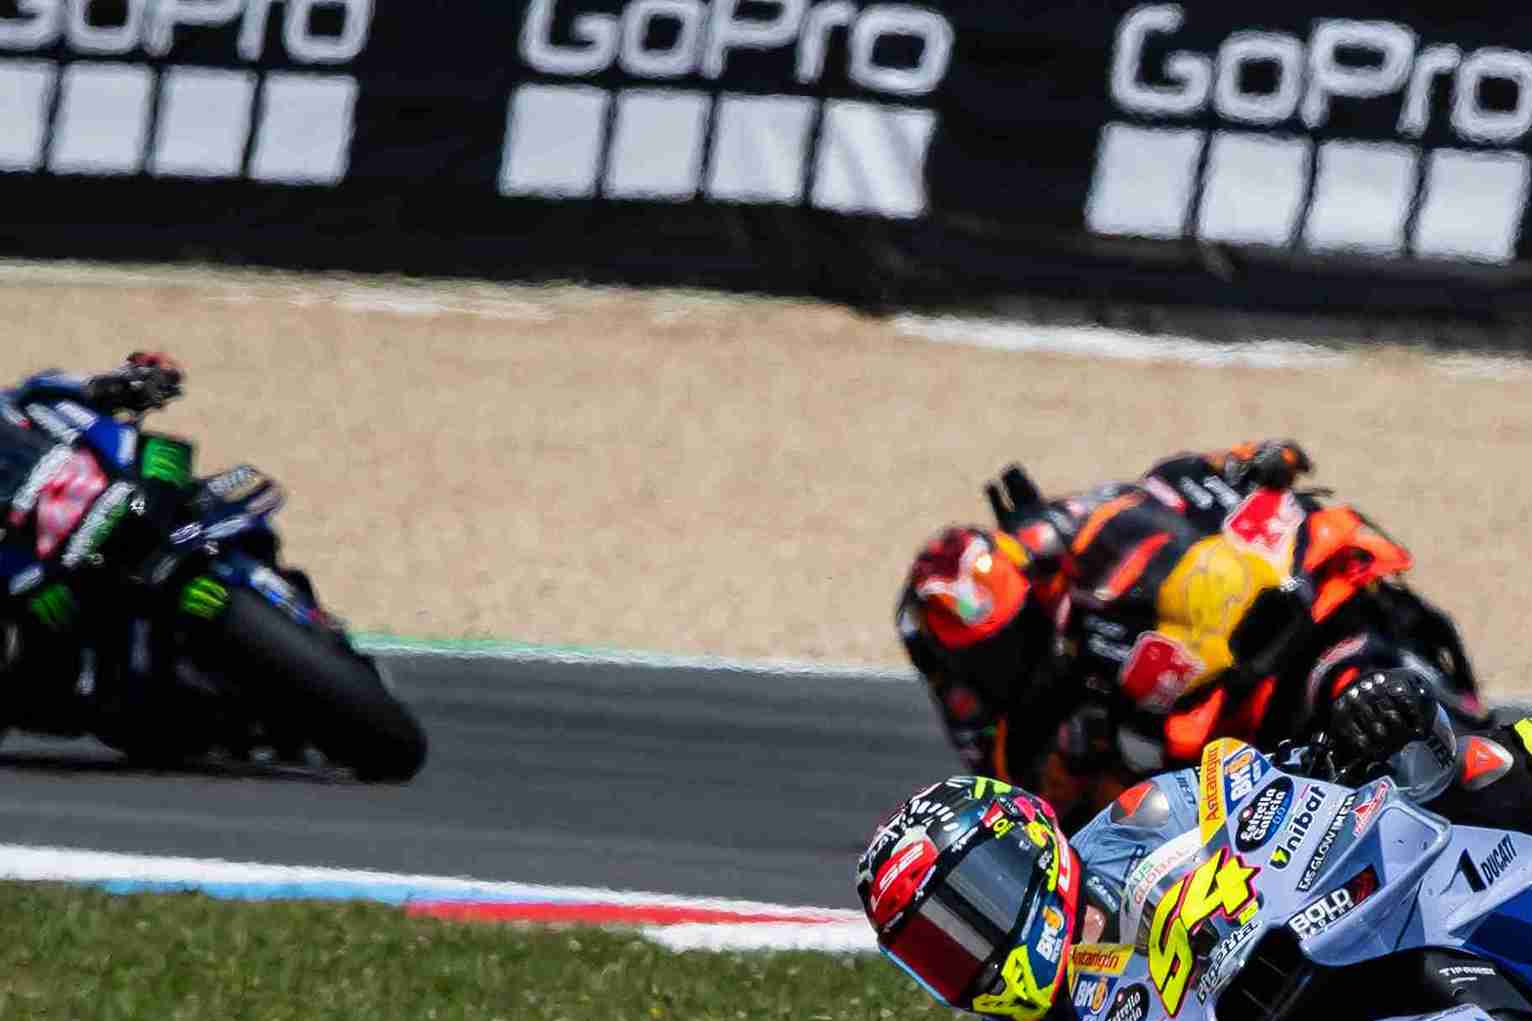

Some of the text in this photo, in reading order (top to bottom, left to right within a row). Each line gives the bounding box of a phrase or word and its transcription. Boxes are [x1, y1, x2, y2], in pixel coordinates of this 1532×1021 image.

[0, 0, 373, 63] oPro
[518, 0, 956, 95] GoPro
[1240, 787, 1278, 841] Estrella
[1251, 791, 1286, 840] Galicia
[1268, 785, 1328, 871] Unibat
[1480, 833, 1517, 885] DUCATI
[1148, 845, 1262, 1018] 54
[1288, 888, 1351, 932] BOLD
